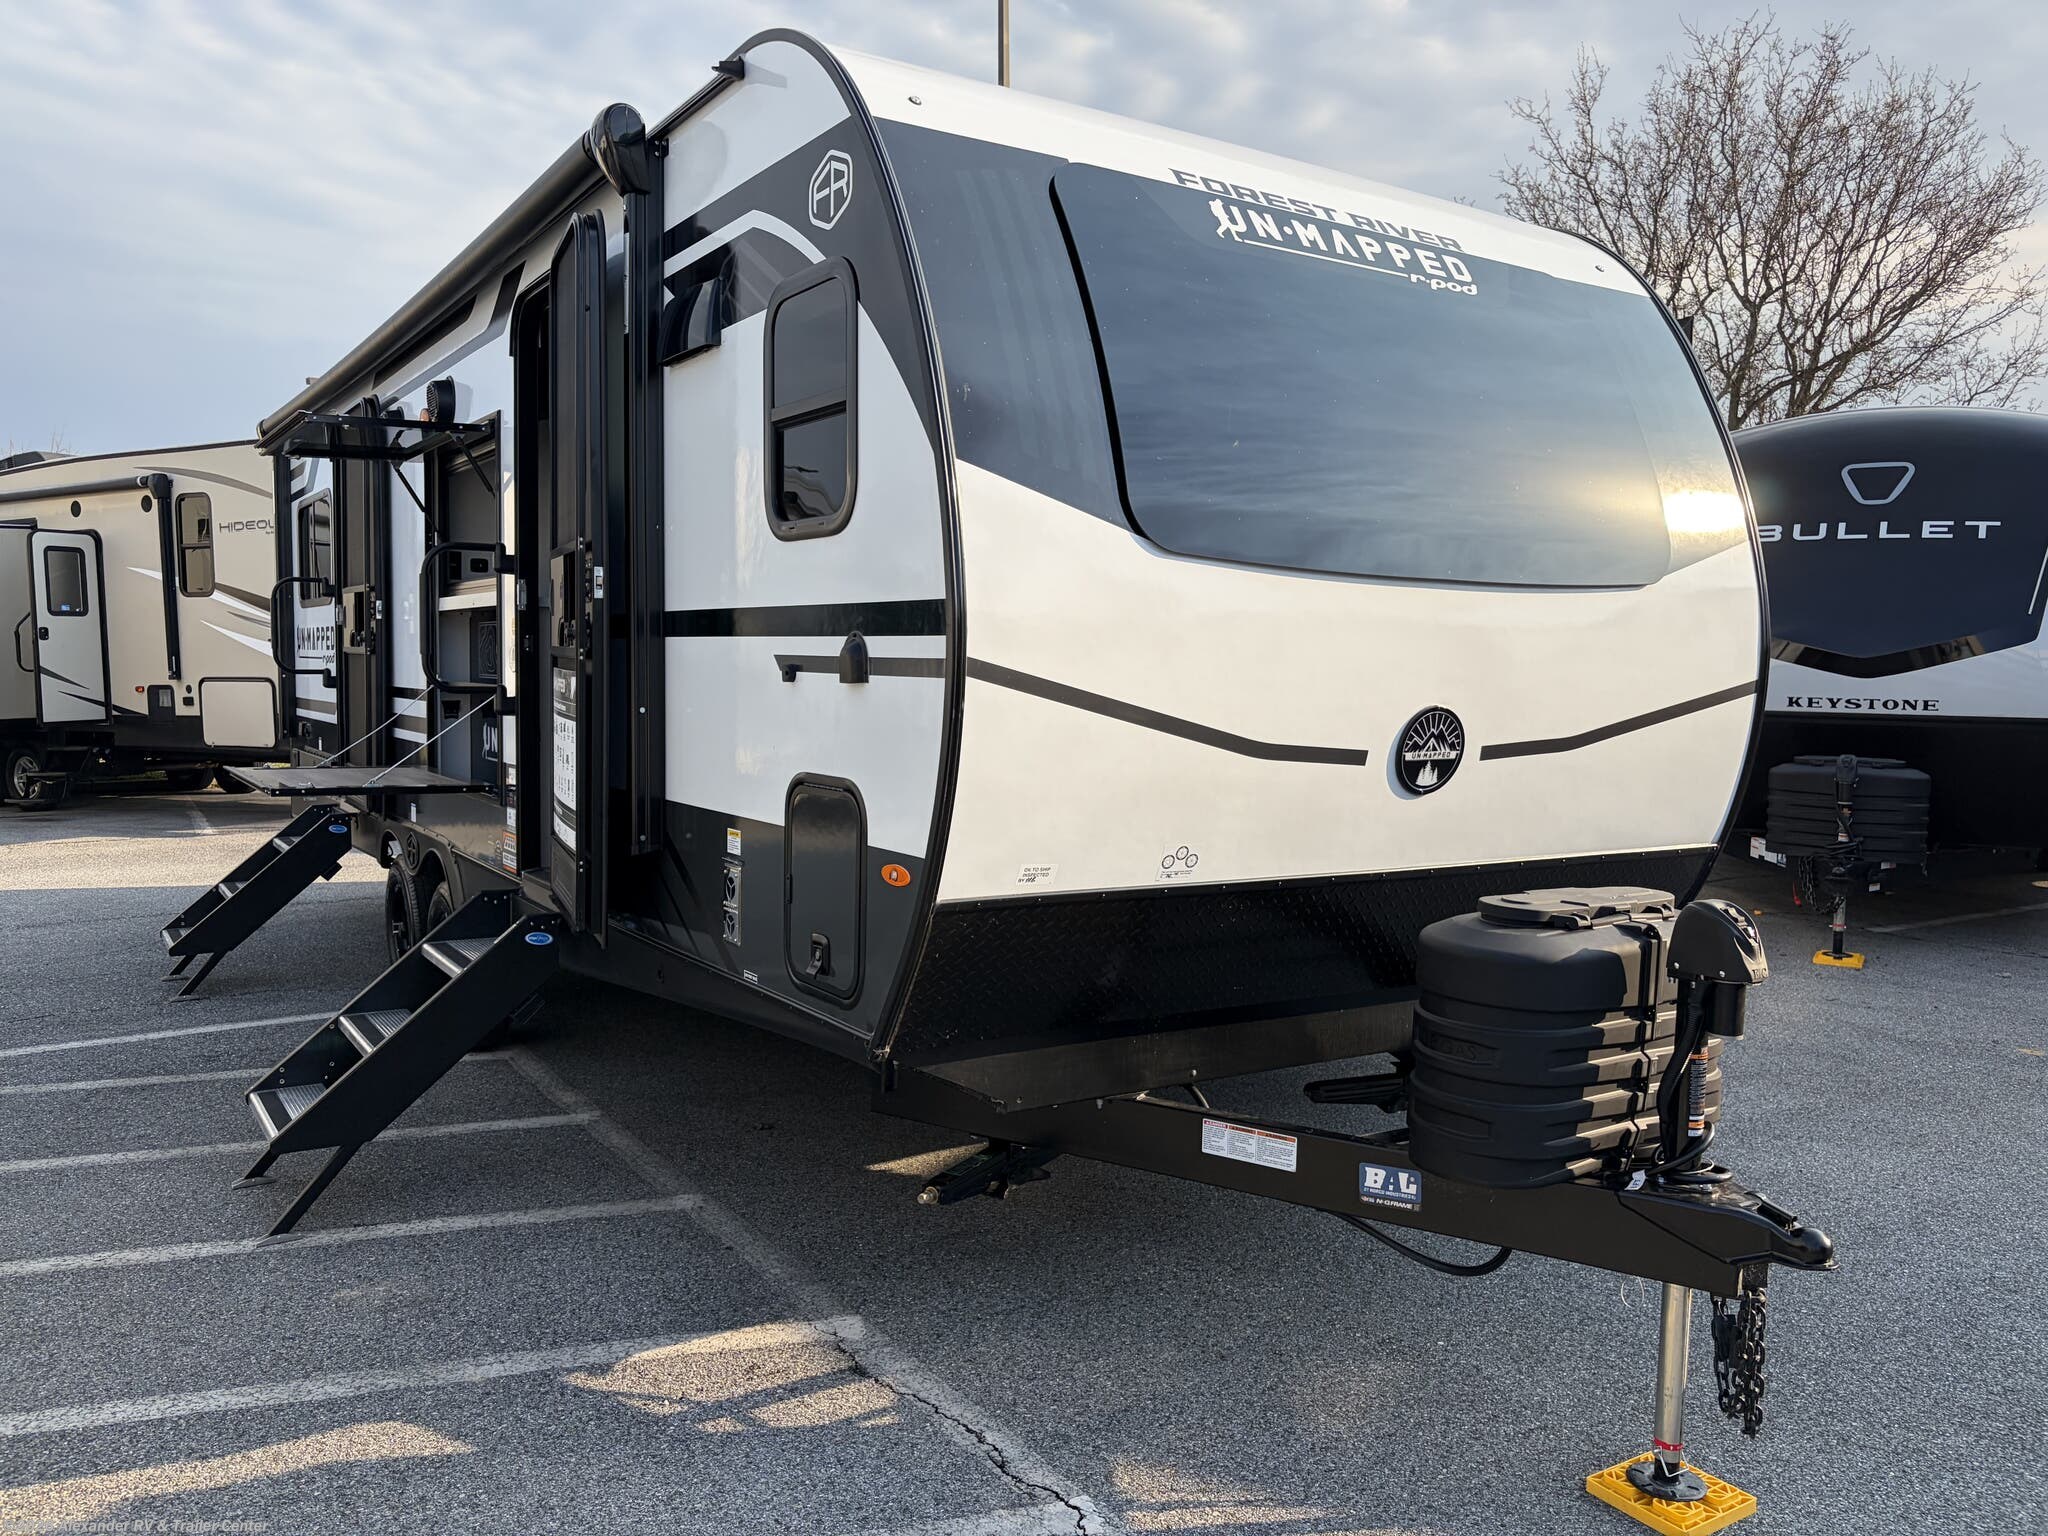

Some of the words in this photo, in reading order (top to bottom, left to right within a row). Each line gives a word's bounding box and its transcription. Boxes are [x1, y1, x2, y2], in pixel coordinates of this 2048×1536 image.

[1168, 167, 1337, 222] FOREST
[1346, 211, 1465, 252] RIVER
[1758, 520, 2002, 542] BULLET
[1787, 696, 1939, 712] KEYSTONE
